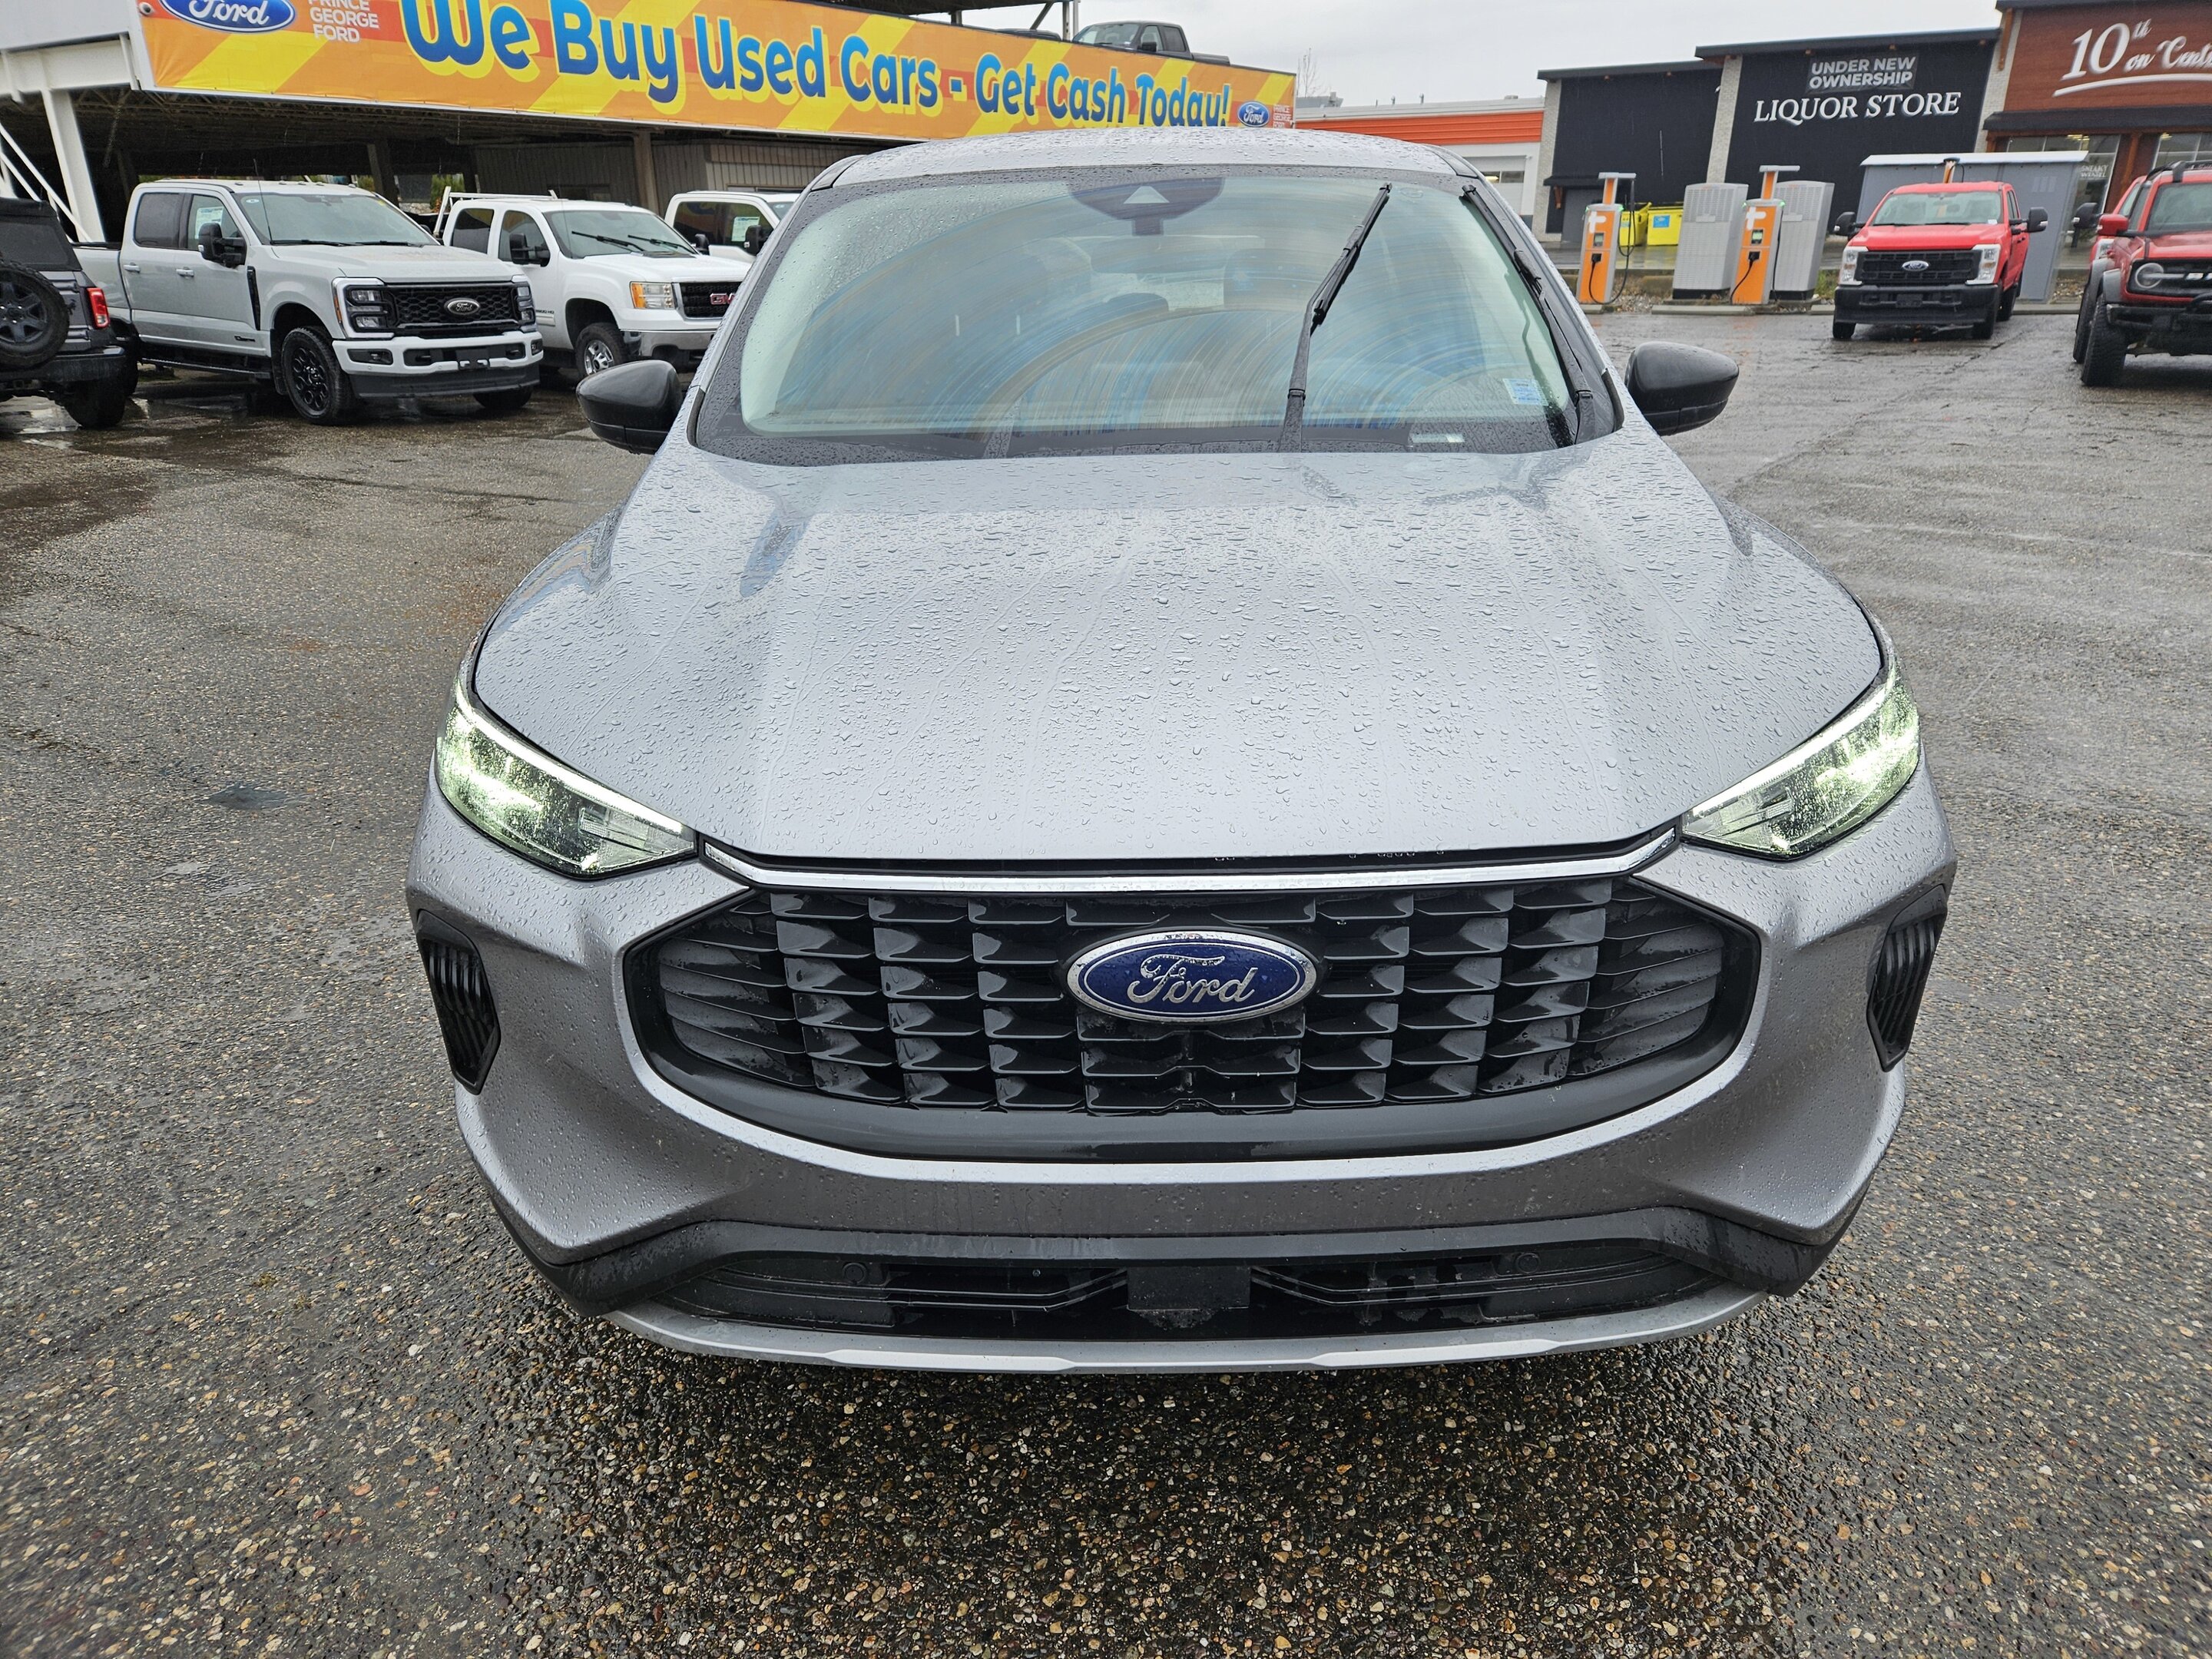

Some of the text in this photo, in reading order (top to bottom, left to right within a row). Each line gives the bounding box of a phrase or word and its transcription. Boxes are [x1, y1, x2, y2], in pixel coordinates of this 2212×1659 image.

[188, 0, 270, 25] Ford
[310, 6, 379, 28] GEORGE
[313, 24, 359, 43] FORD
[401, 0, 531, 70] We
[549, 0, 679, 104] Buy
[694, 15, 826, 98] Used
[843, 36, 938, 108] Cars
[976, 54, 1036, 116] Get
[1048, 63, 1126, 123] Cash
[1136, 74, 1230, 127] Today!
[1811, 56, 1917, 75] UNDER NEW
[2123, 53, 2157, 73] on
[1809, 71, 1913, 90] OWNERSHIP
[1243, 104, 1266, 124] Ford
[1753, 91, 1962, 126] LIQUOR STORE
[455, 303, 473, 312] Ford
[1127, 954, 1259, 1004] Ford
